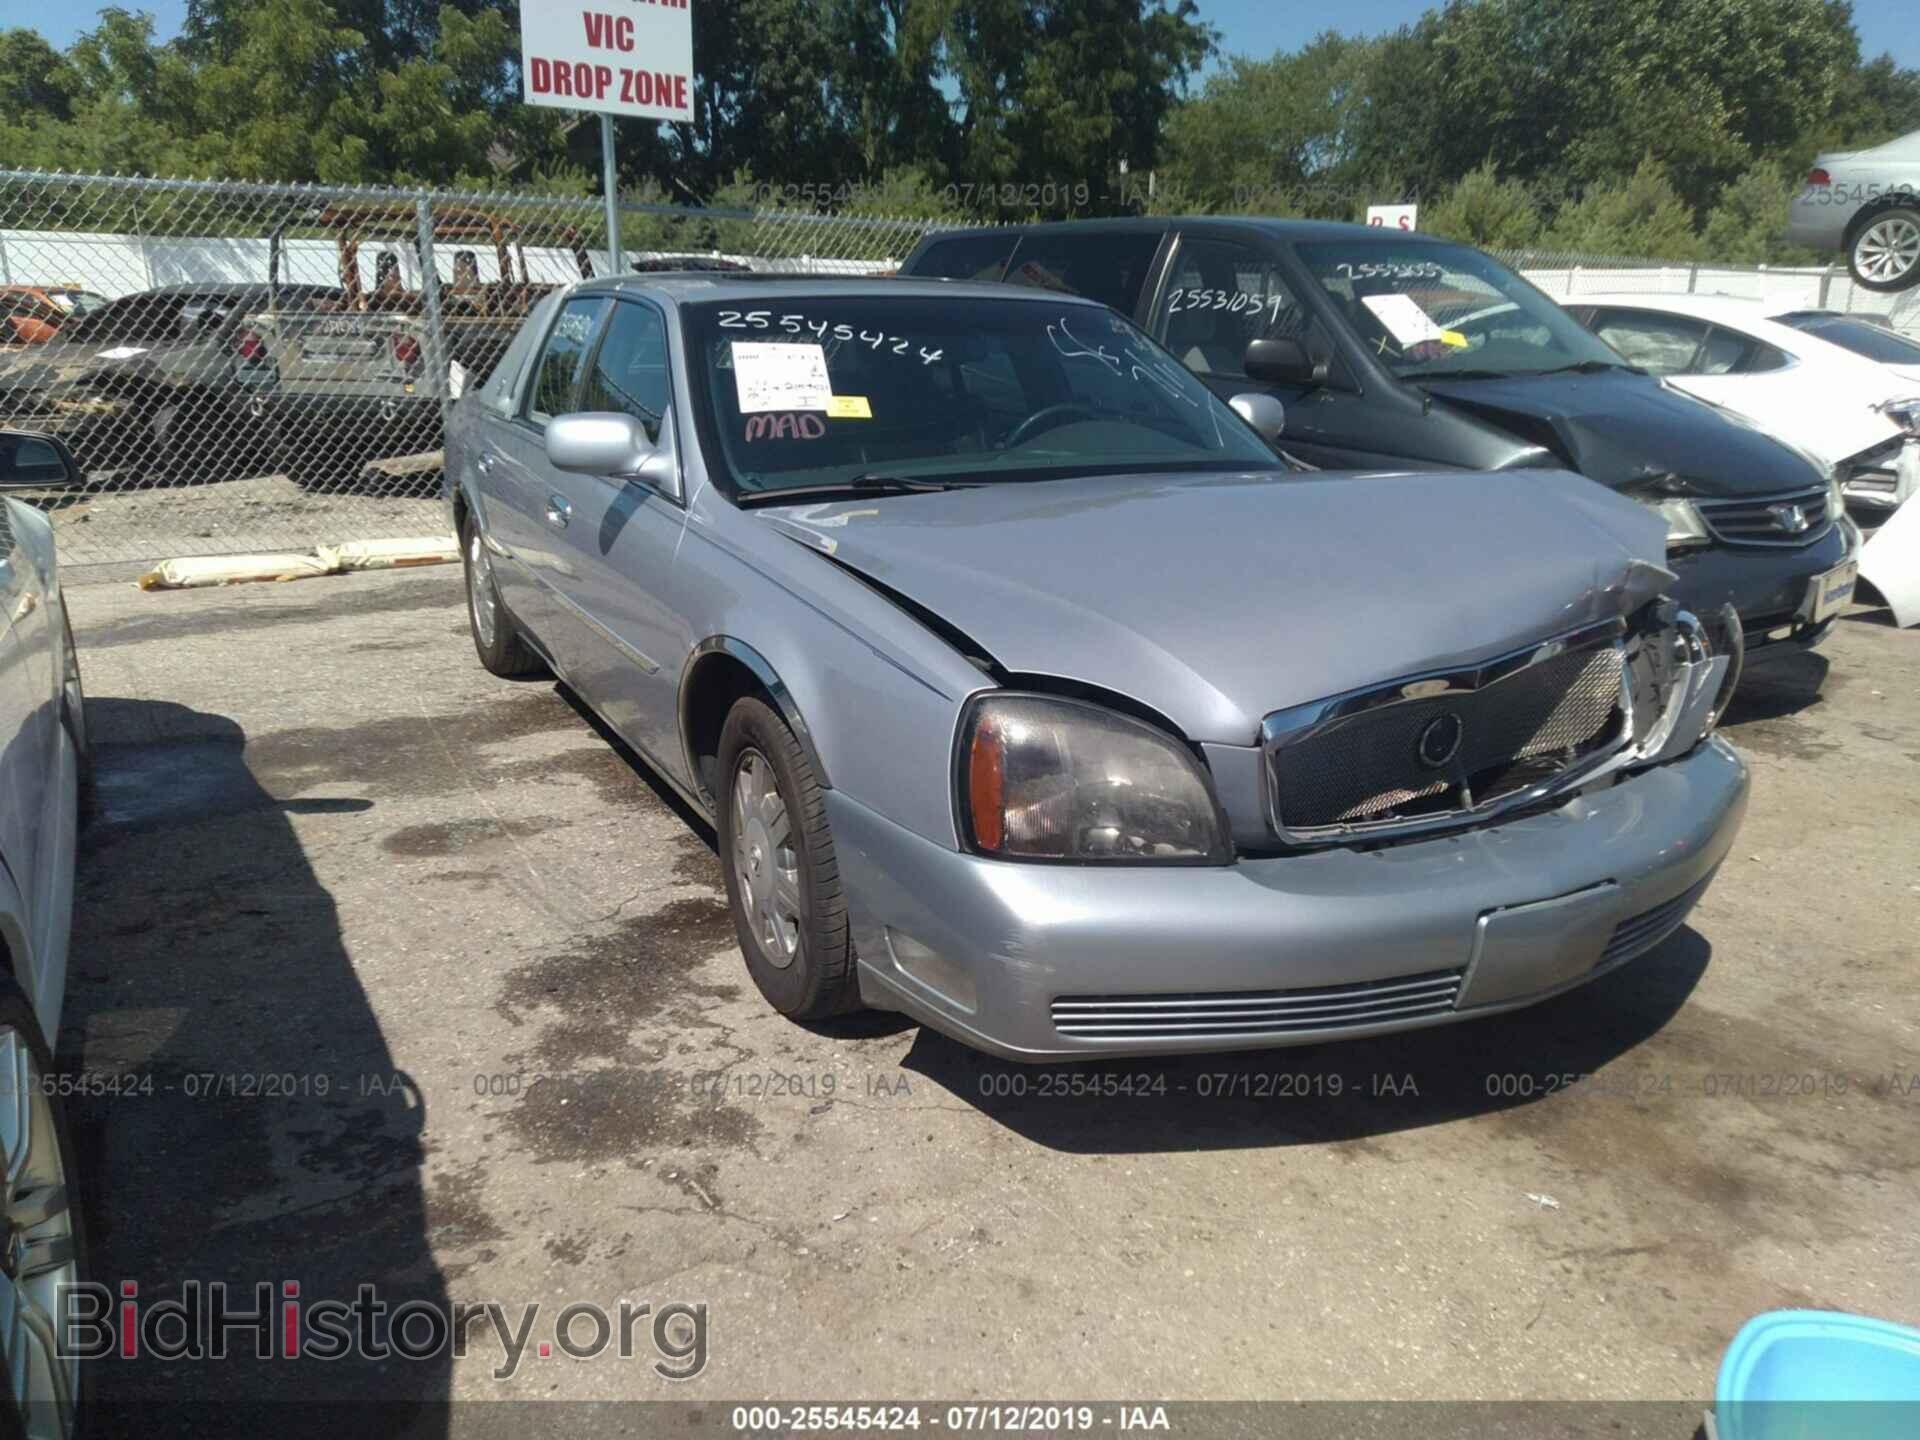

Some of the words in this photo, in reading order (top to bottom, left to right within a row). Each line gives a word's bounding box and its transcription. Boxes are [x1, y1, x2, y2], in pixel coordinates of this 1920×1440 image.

[583, 12, 635, 52] VIC
[531, 57, 611, 99] DROP
[619, 67, 688, 109] ZONE
[1168, 289, 1282, 325] 25531059
[717, 311, 944, 364] 25545424
